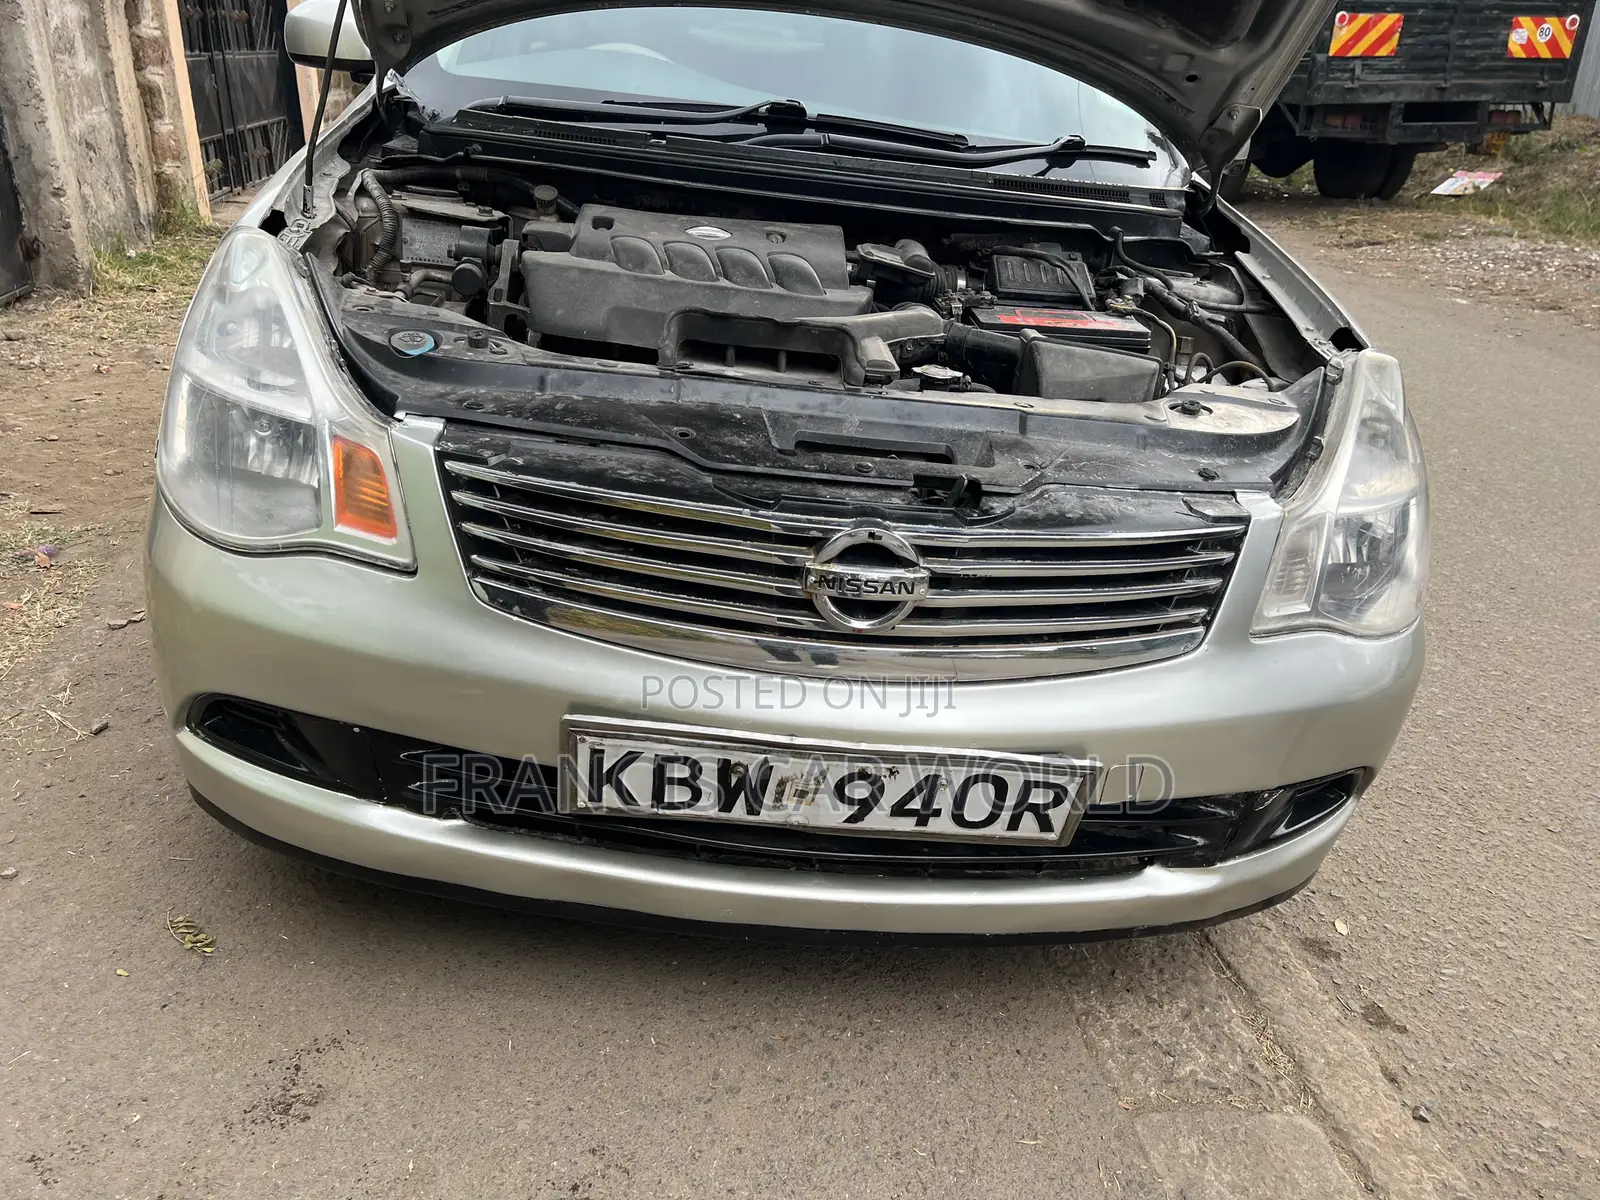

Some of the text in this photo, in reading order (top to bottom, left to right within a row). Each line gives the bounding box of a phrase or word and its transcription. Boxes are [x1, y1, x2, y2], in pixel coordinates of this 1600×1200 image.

[1538, 26, 1551, 38] 80
[815, 574, 916, 595] NISSAN
[587, 747, 1069, 833] KBW 940R
